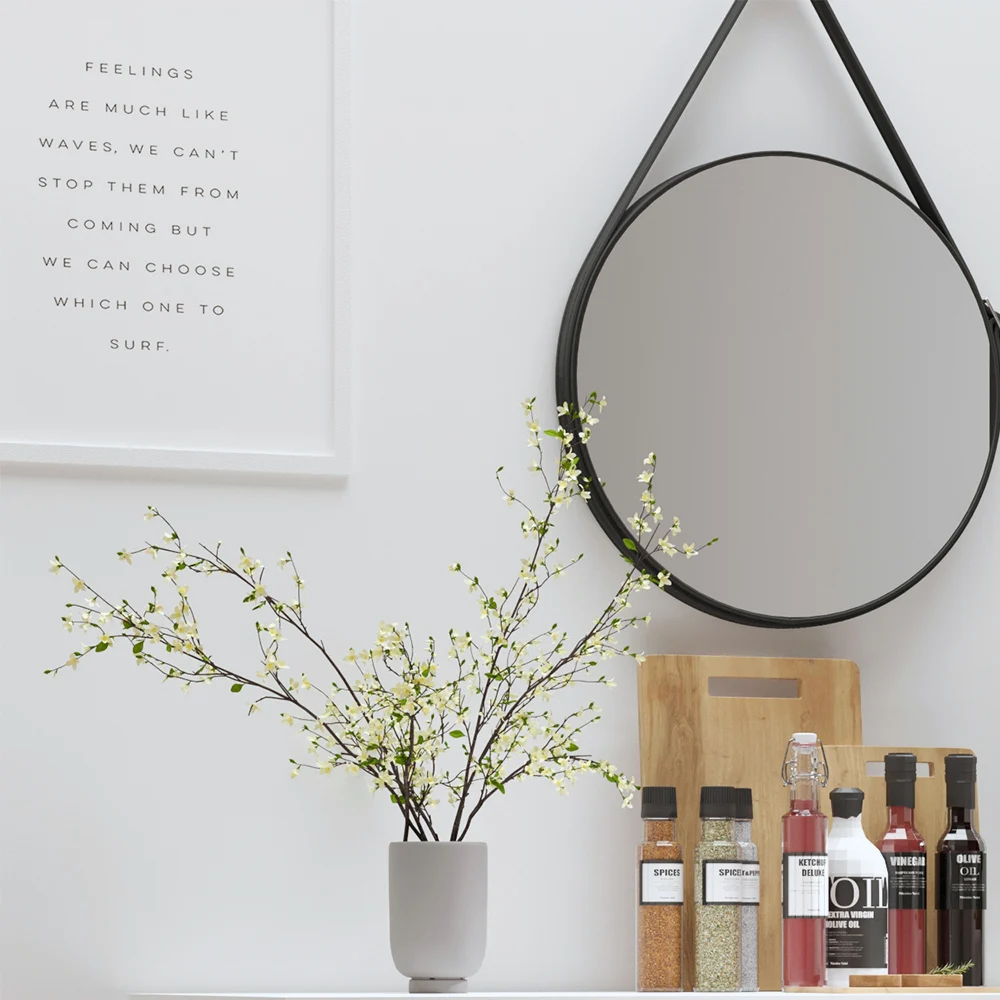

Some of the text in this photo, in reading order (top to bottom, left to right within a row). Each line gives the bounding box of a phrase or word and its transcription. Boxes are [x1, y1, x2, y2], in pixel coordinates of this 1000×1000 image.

[85, 61, 194, 80] FEELINGS
[48, 98, 229, 122] ARE MUCH LIKE
[38, 137, 239, 161] WAVES, WE CAN'T
[37, 176, 239, 200] STOP THEM FROM
[66, 217, 212, 237] COMING BUT
[42, 256, 235, 278] WE CAN CHOOSE
[53, 296, 226, 317] WHICH ONE TO
[109, 338, 170, 353] SURF.
[956, 853, 982, 864] OLIVE
[653, 868, 681, 877] SPICES
[959, 866, 980, 876] OIL
[827, 910, 875, 919] EXTRA VIRGIN
[848, 920, 861, 929] OIL
